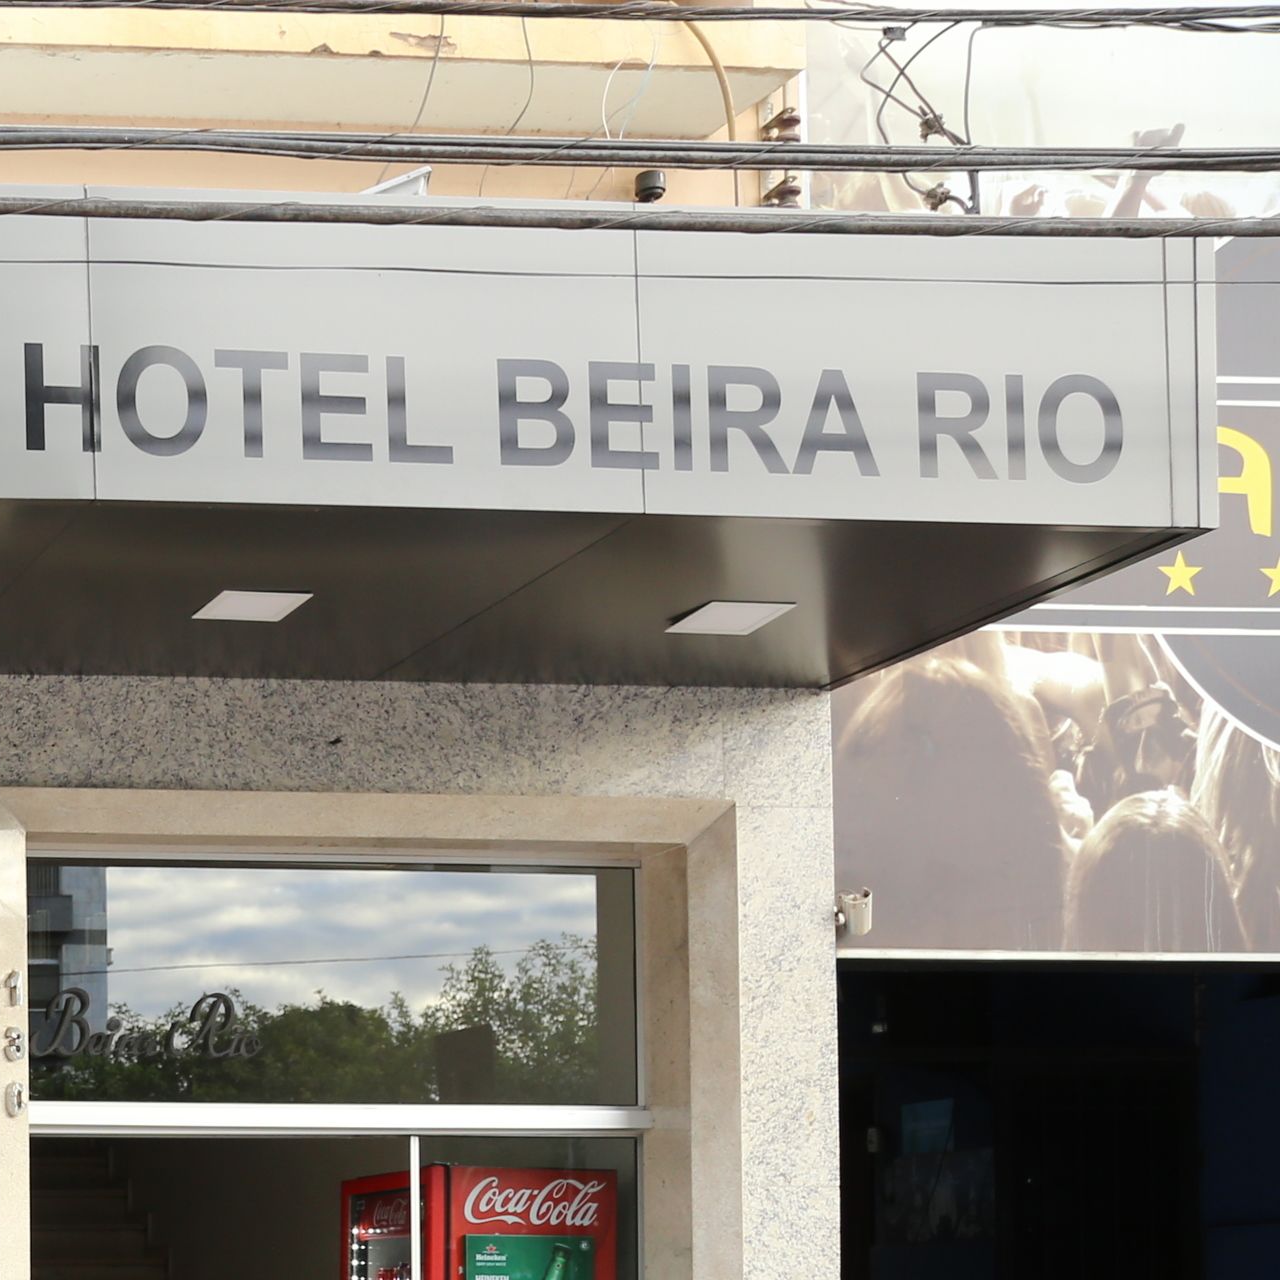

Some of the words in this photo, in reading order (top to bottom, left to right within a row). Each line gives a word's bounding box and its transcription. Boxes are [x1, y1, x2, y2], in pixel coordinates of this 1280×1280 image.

[23, 343, 454, 465] HOTEL
[495, 357, 881, 479] BEIRA
[915, 371, 1125, 484] RIO
[30, 987, 158, 1057] Beira
[166, 992, 263, 1058] Rio
[464, 1176, 607, 1227] Coca-Cola
